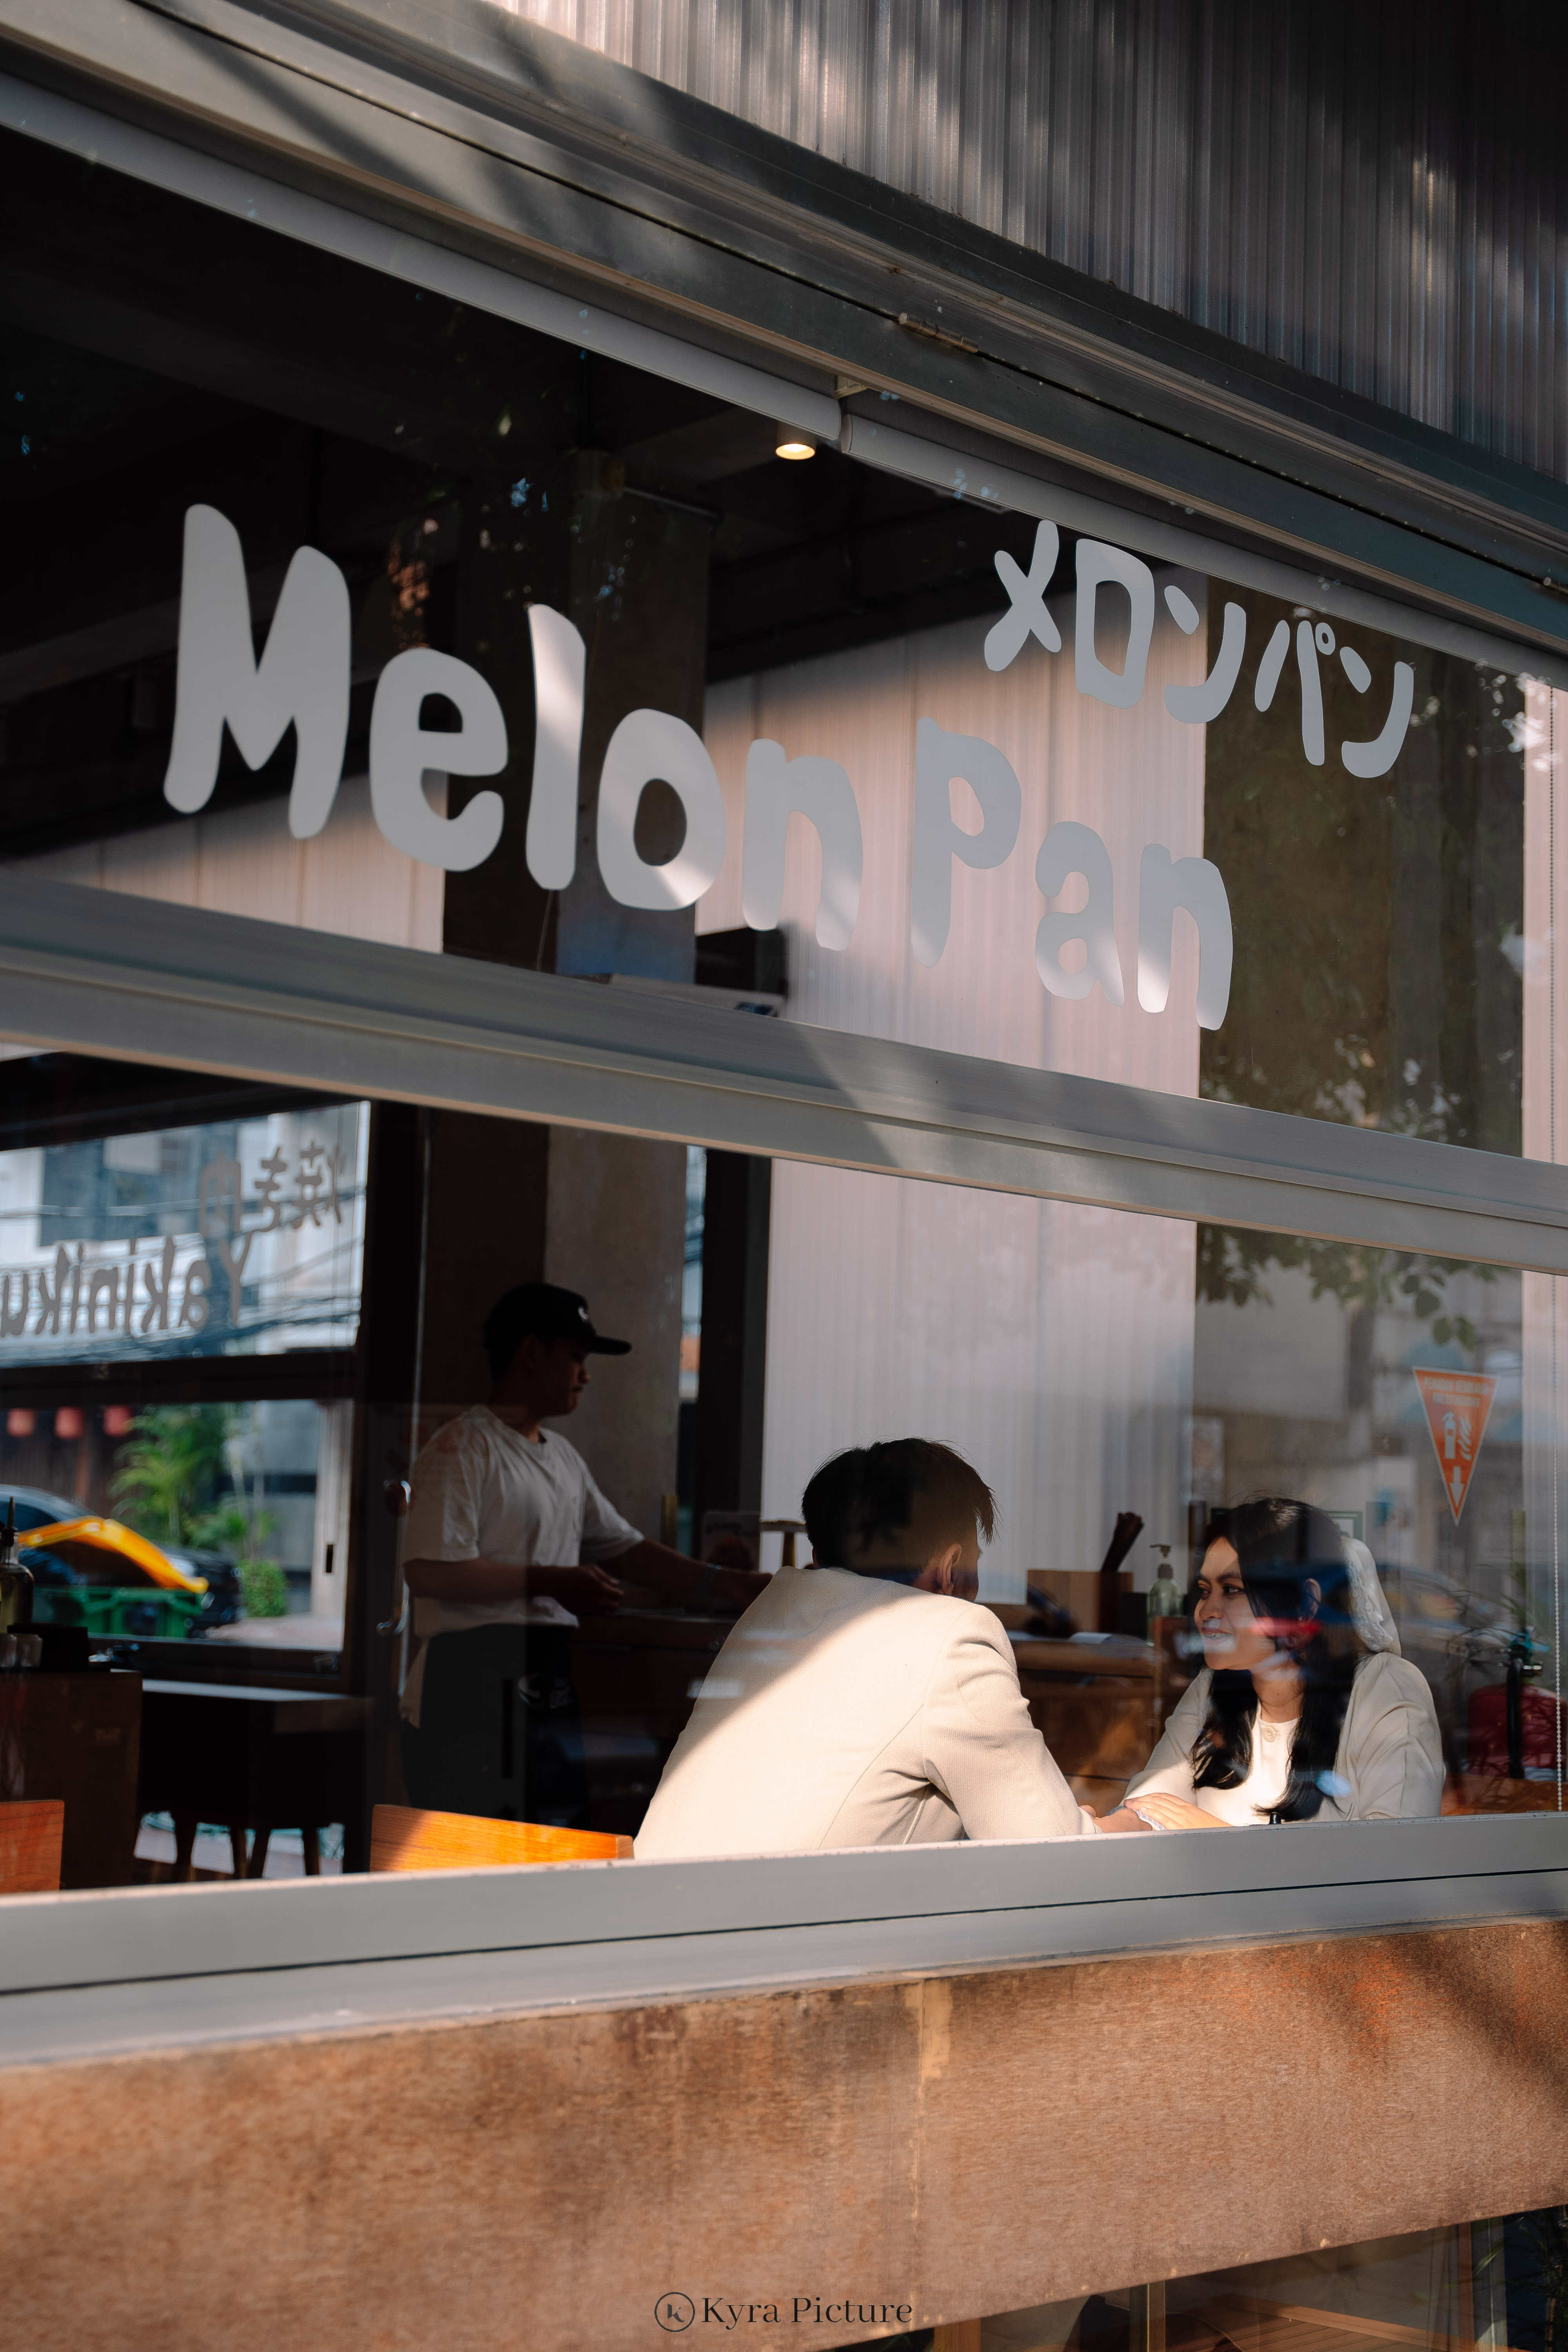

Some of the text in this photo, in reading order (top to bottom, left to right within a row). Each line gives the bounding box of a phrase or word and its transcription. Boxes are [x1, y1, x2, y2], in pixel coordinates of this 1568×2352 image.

[164, 504, 1233, 1031] Melon Pan
[984, 520, 1414, 778] メロンパン
